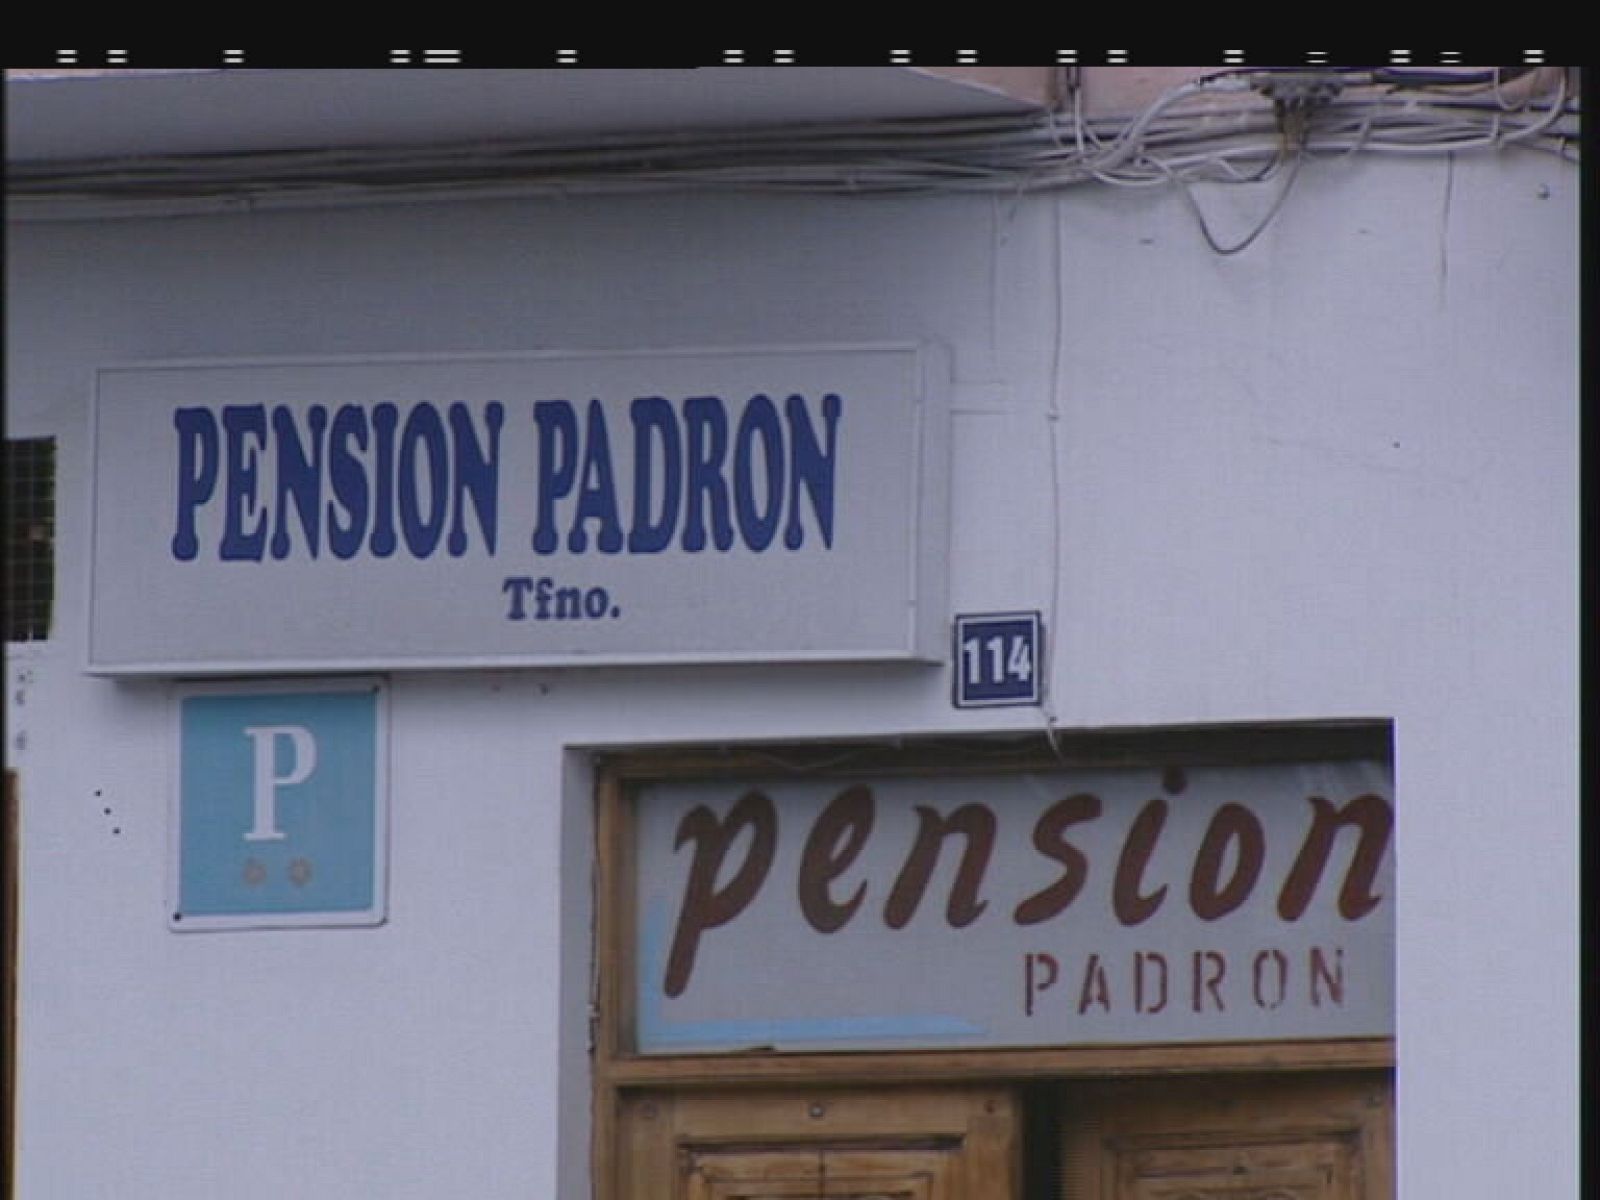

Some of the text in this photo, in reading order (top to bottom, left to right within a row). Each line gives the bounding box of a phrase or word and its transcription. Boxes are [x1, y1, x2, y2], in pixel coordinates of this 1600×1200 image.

[171, 393, 842, 562] PENSION PADRON
[503, 577, 622, 620] Tfno.
[961, 636, 1031, 684] 114
[243, 725, 317, 841] P
[663, 765, 1394, 998] pension
[1024, 947, 1345, 1017] PADRON
